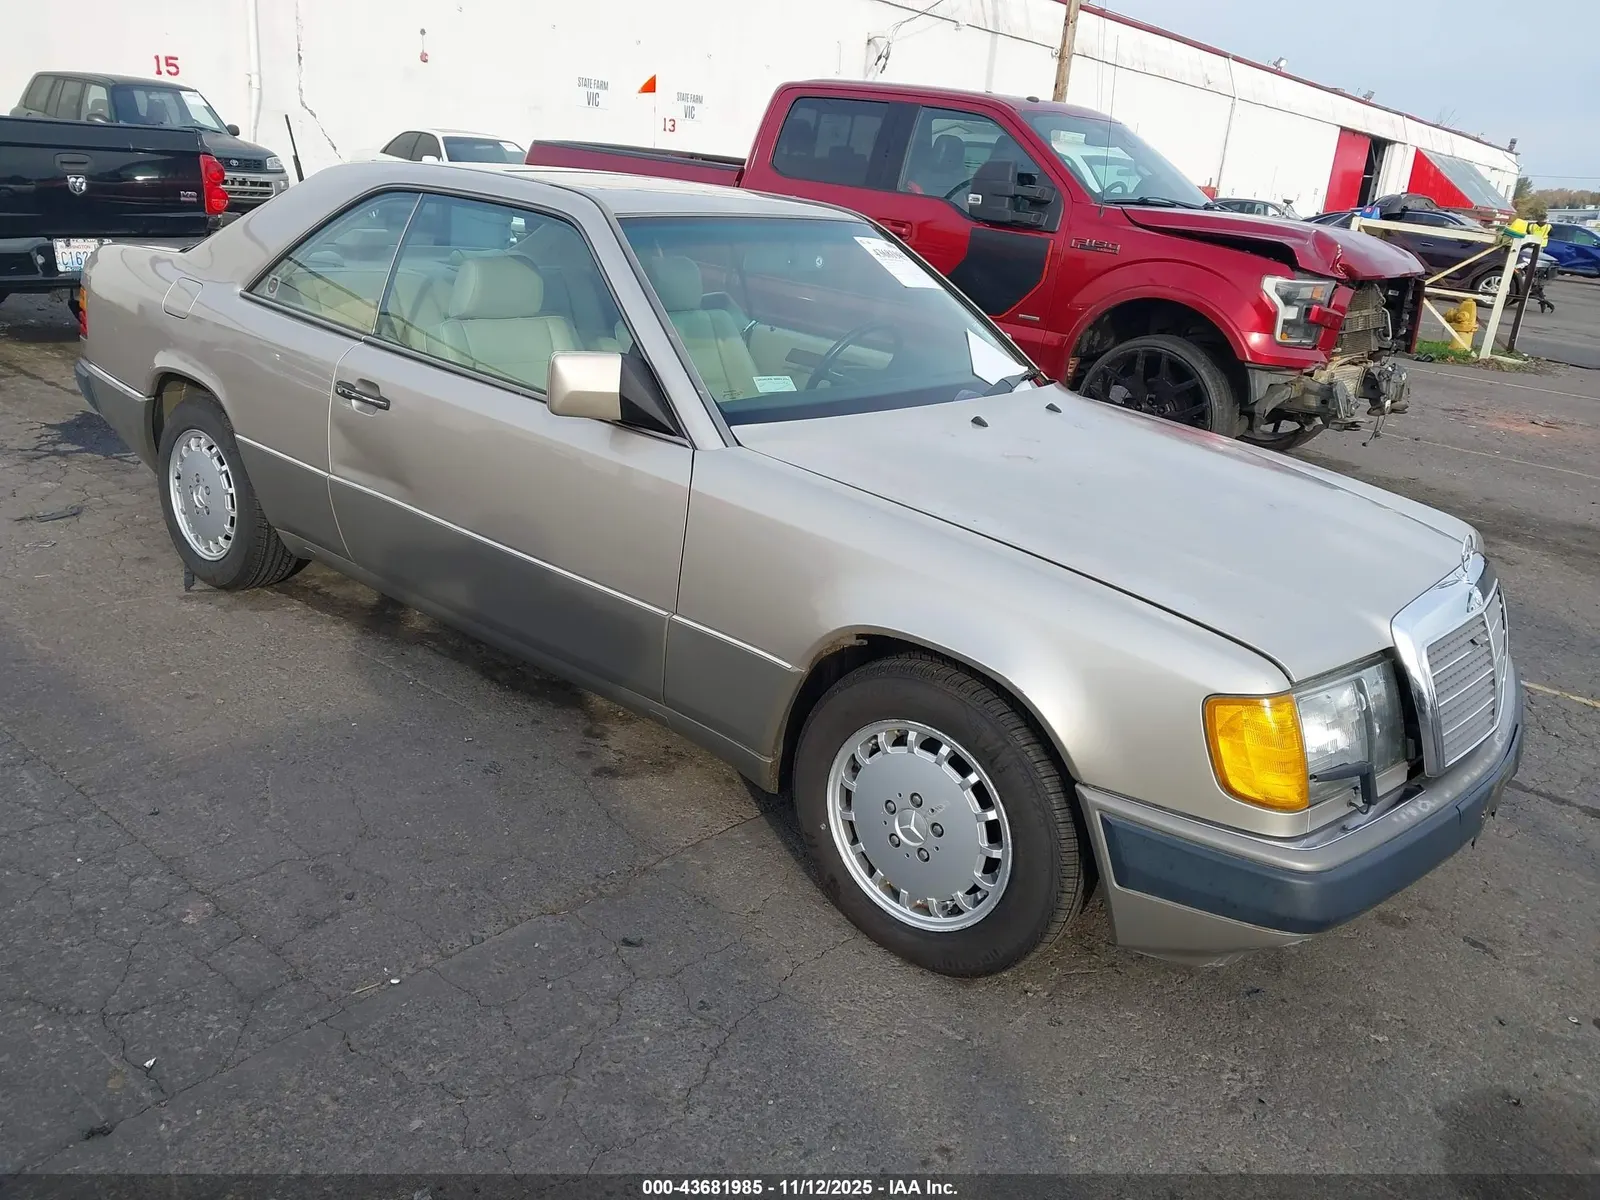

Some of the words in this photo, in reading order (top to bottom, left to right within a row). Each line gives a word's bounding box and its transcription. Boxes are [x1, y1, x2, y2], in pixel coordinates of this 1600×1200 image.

[154, 54, 180, 76] 15
[577, 76, 593, 89] STATE
[593, 79, 609, 91] FARM
[586, 91, 600, 107] VIC
[676, 92, 690, 103] STATE
[689, 93, 704, 104] FARM
[683, 105, 696, 120] VIC
[662, 117, 676, 133] 13
